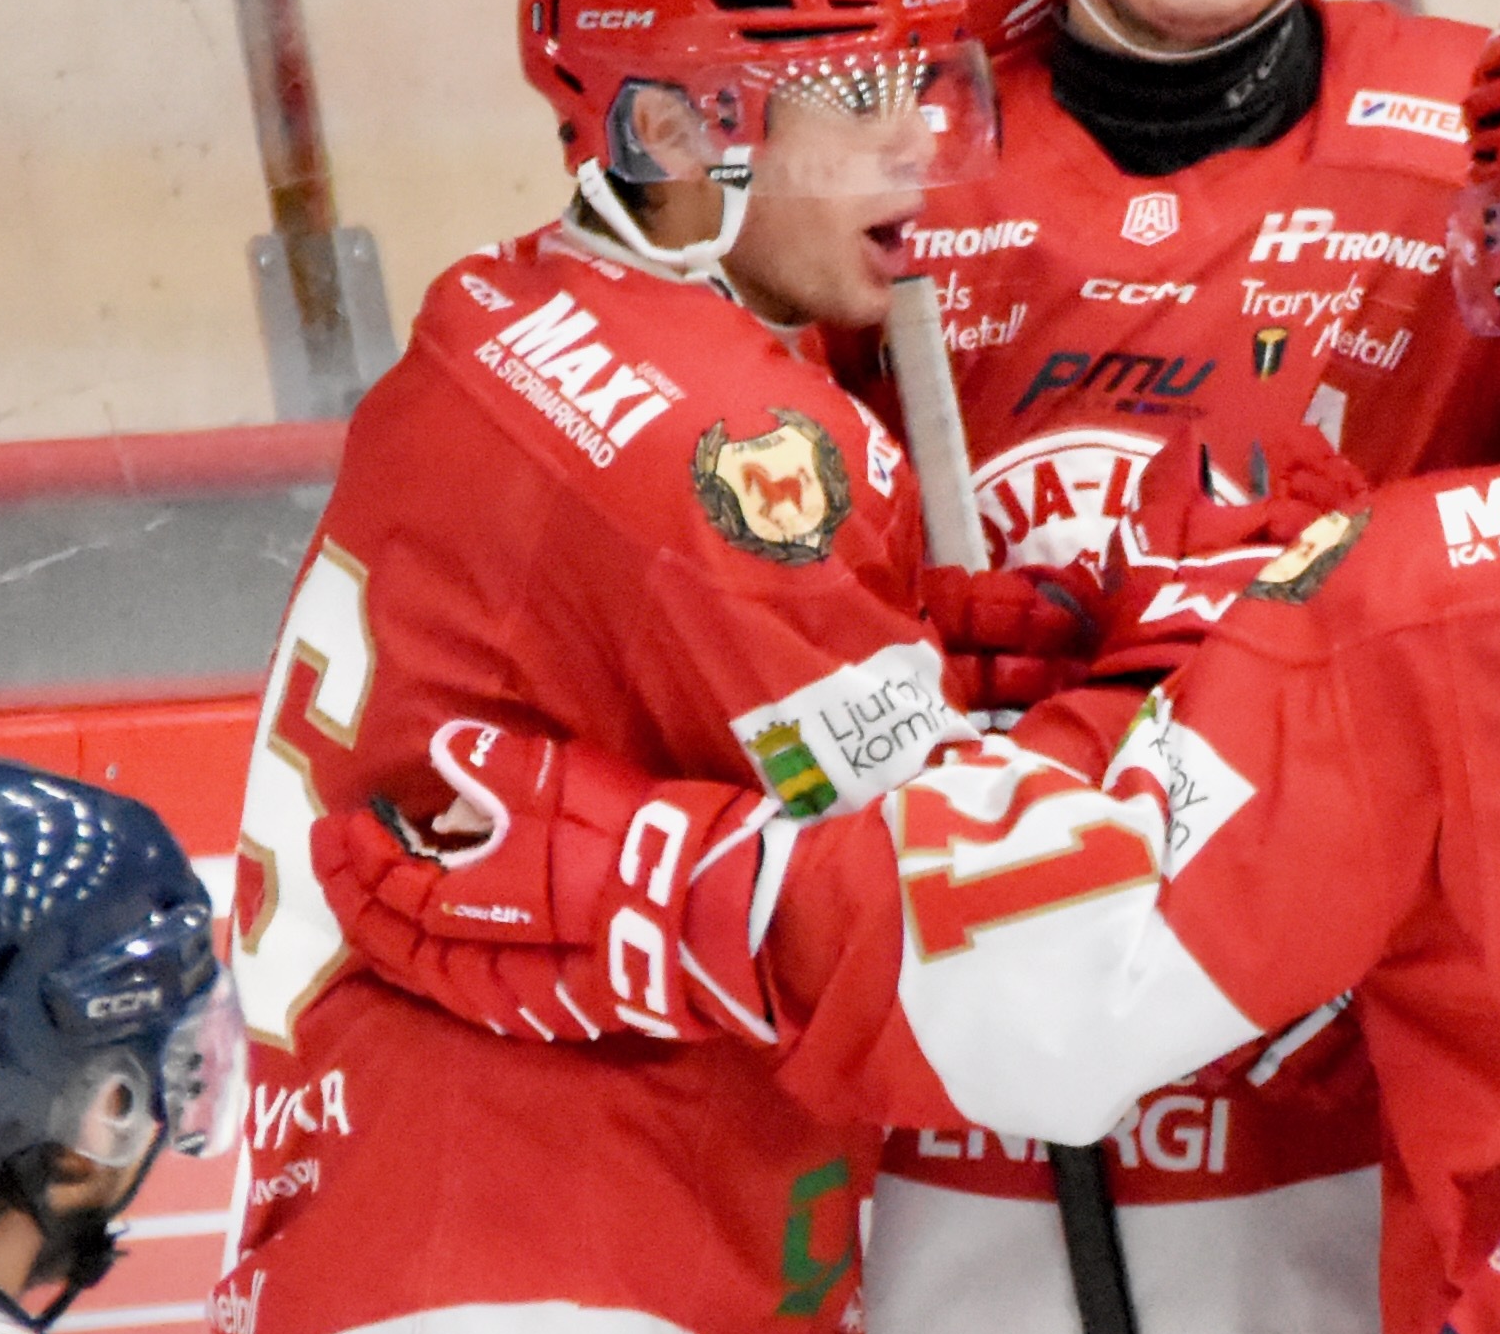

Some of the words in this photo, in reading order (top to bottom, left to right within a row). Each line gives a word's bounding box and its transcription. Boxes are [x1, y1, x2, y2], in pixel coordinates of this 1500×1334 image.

[576, 9, 655, 30] CCM
[1079, 278, 1198, 306] CCM
[1240, 272, 1365, 327] Traryds
[1312, 317, 1414, 372] Metall
[498, 289, 671, 448] MAXI
[1448, 543, 1496, 568] ICA
[86, 990, 163, 1019] CCM
